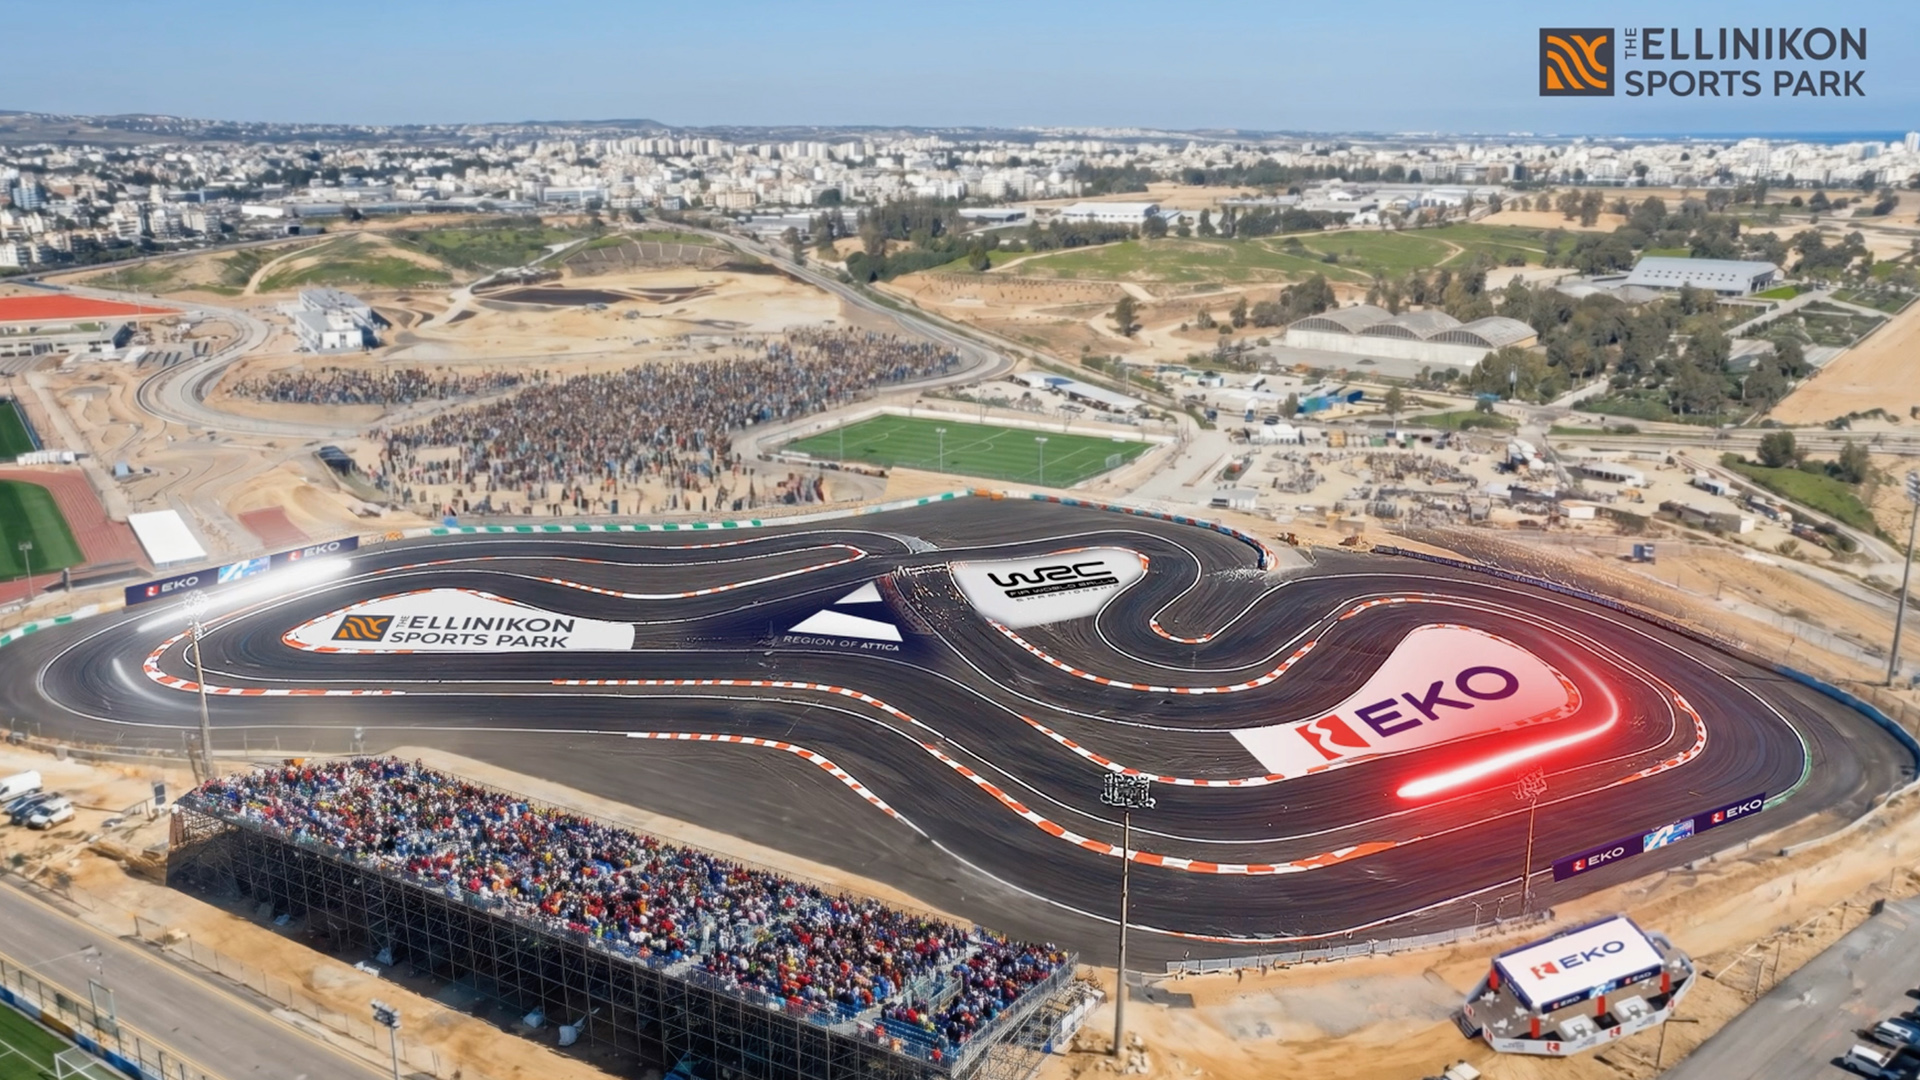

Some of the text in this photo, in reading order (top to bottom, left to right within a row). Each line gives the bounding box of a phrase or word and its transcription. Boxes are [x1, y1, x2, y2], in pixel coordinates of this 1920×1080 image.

[303, 541, 341, 558] EKO
[987, 561, 1112, 587] WRC
[161, 576, 199, 593] EKO
[407, 615, 575, 634] ELLINIKON
[389, 631, 569, 649] SPORTS PARK
[783, 635, 900, 652] REGION OF ATTICA
[1354, 665, 1519, 738] EKO
[1726, 799, 1763, 819] EKO
[1588, 846, 1625, 867] EKO
[1558, 940, 1625, 970] EKO
